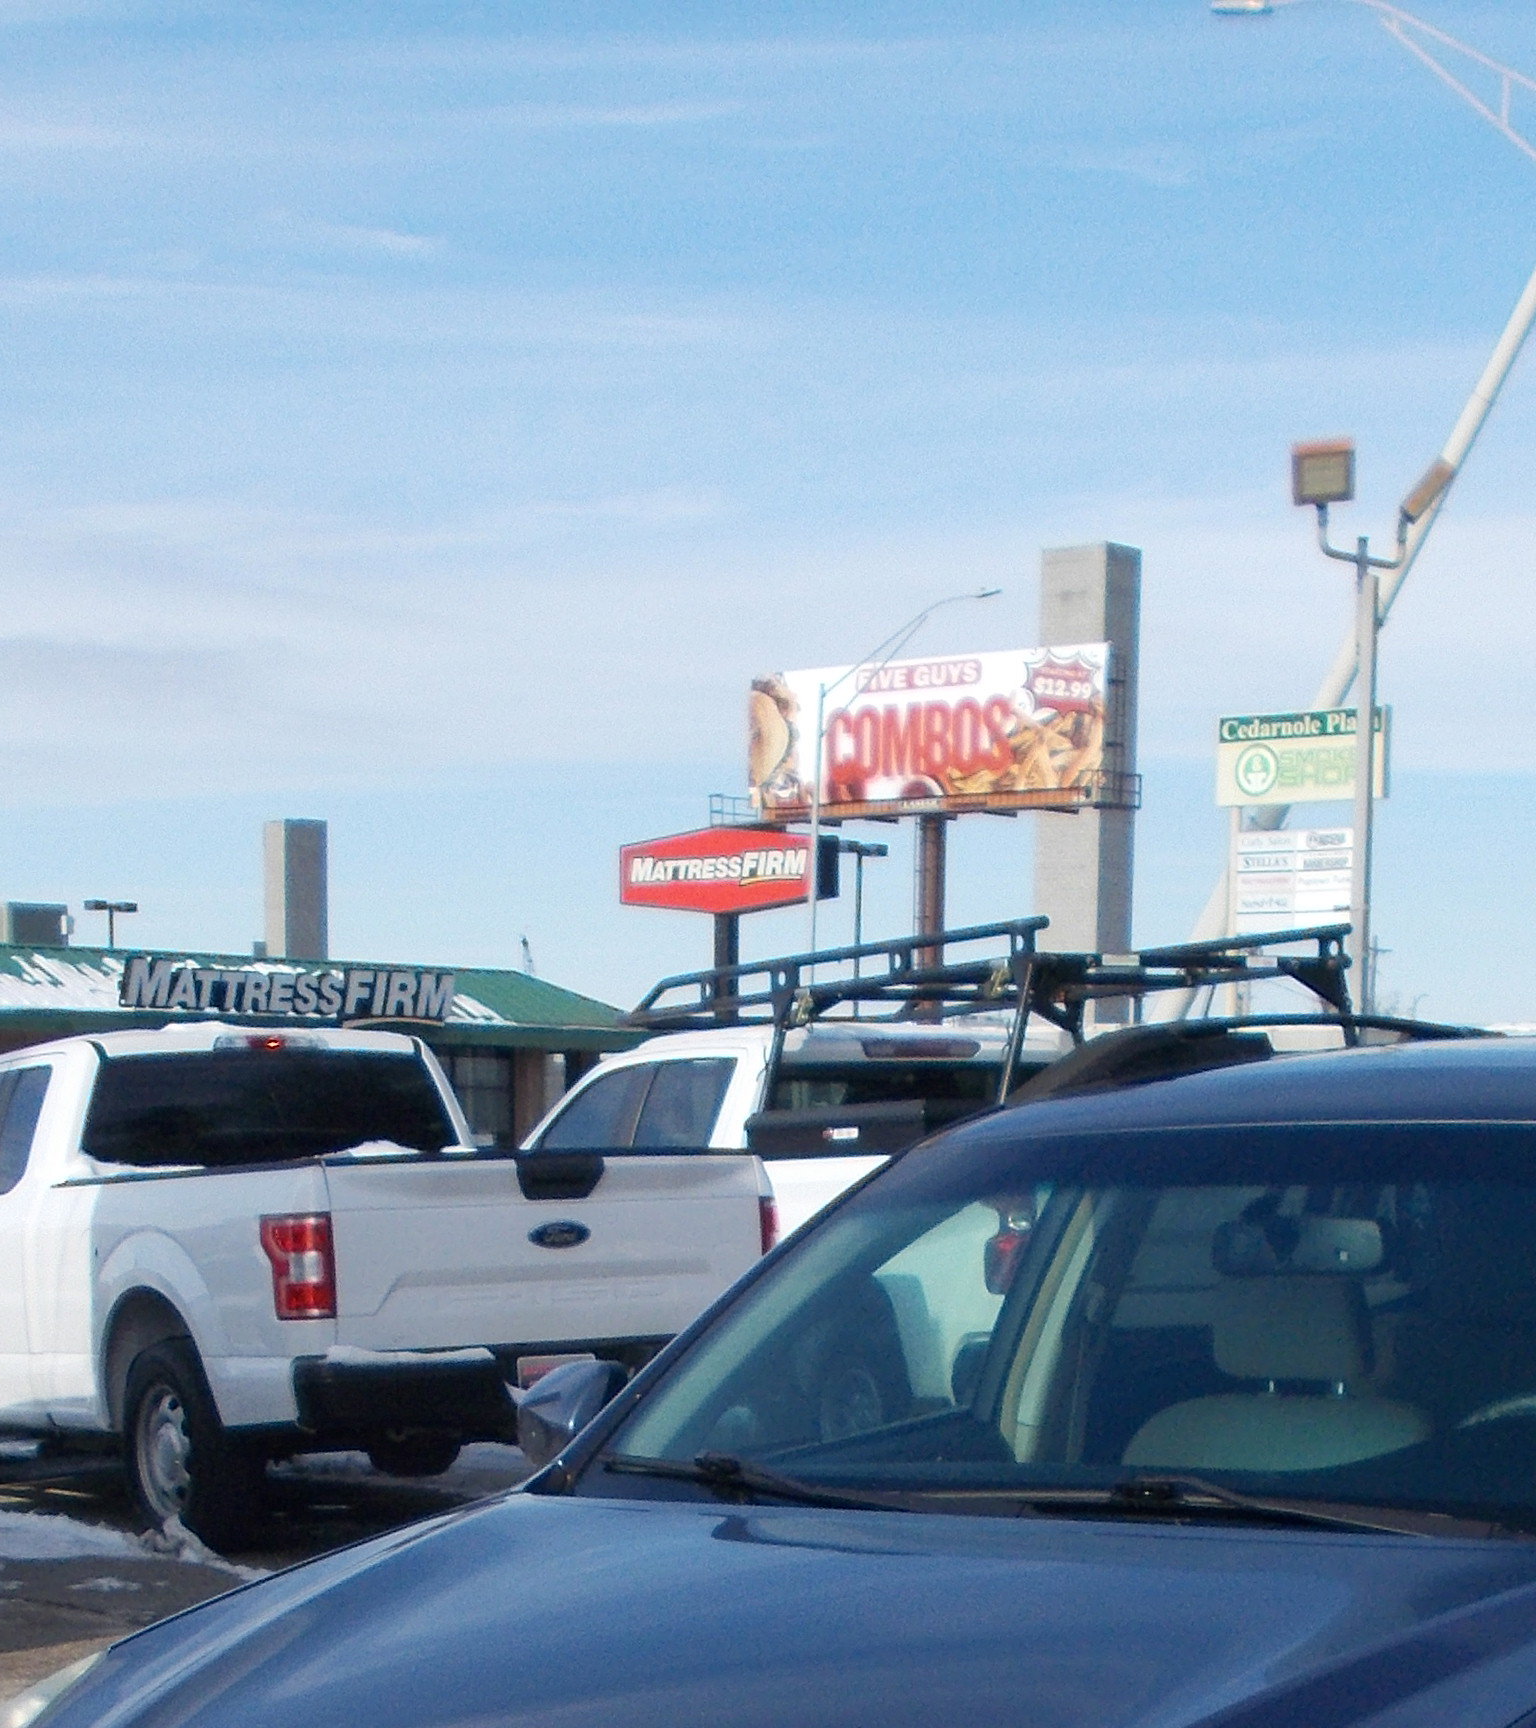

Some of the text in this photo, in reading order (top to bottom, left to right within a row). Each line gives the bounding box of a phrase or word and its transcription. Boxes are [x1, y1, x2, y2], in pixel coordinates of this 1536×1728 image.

[860, 661, 979, 690] FIVE GUYS
[1034, 676, 1091, 699] $12.99
[826, 694, 1015, 783] COMBOS
[1221, 714, 1322, 740] Cedarnole
